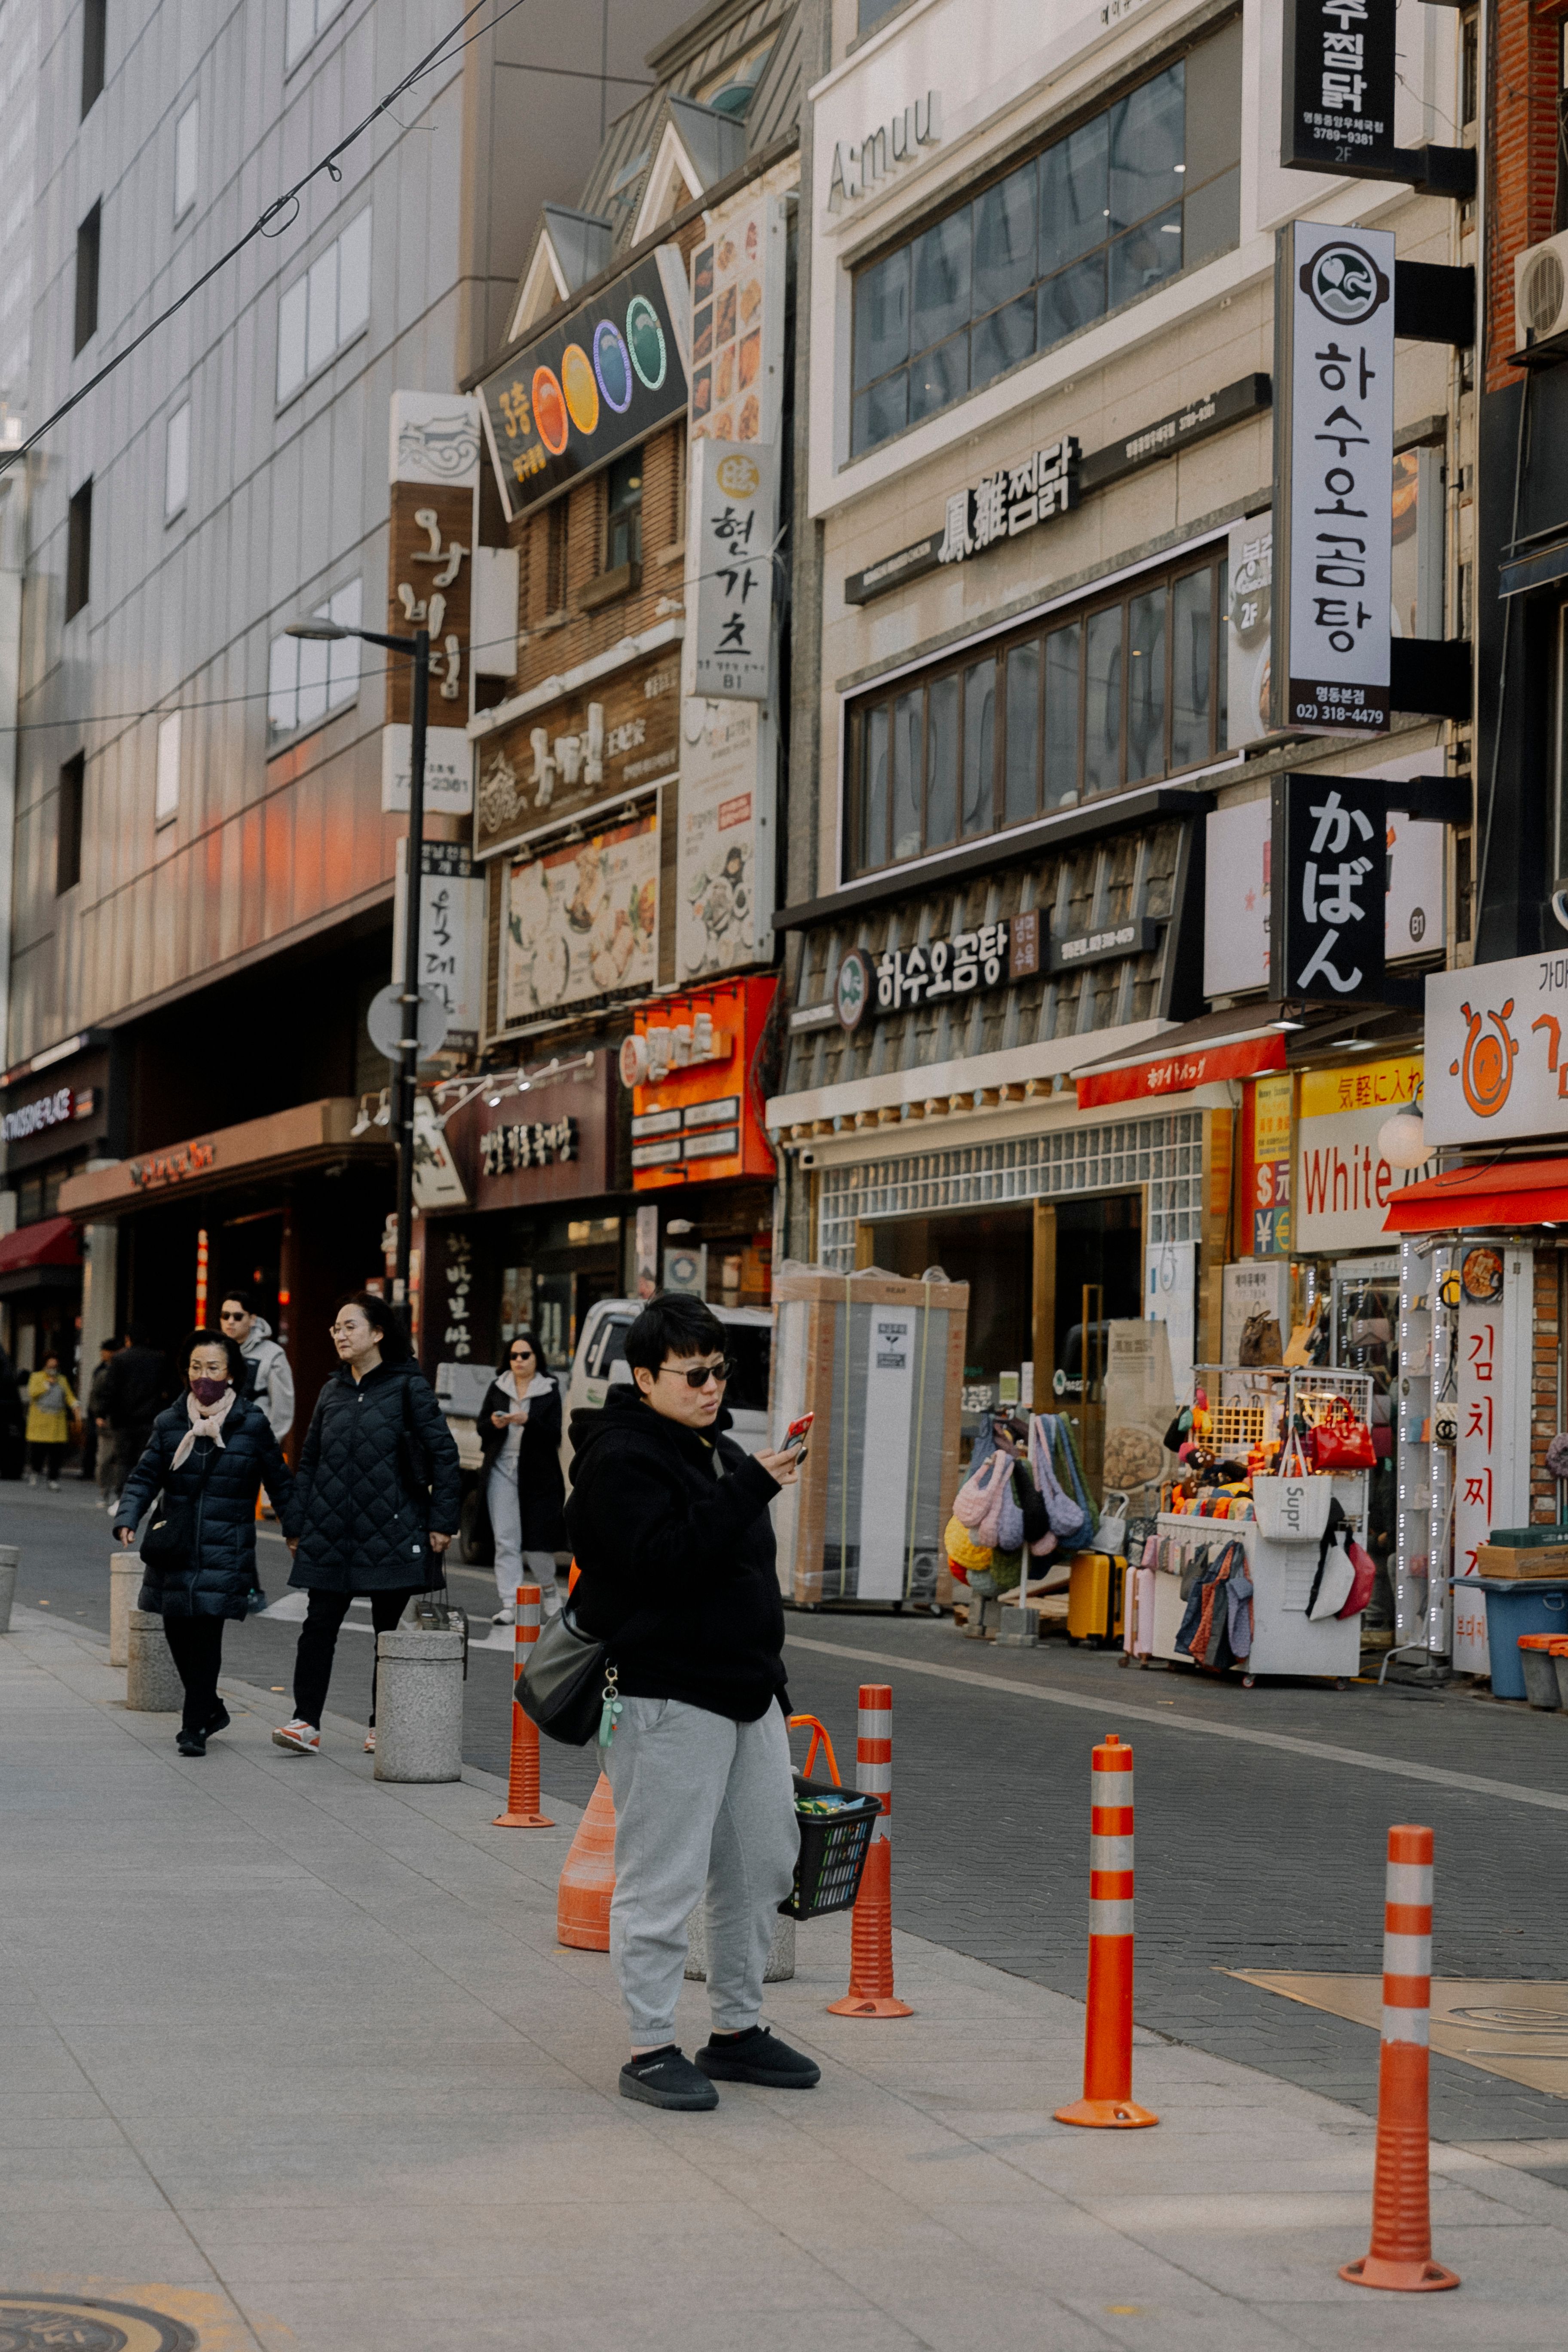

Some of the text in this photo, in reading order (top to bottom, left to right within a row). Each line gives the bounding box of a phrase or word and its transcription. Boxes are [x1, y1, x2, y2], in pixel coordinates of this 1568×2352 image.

[1314, 127, 1373, 145] 3789-9381
[1335, 146, 1352, 162] 2F
[1241, 602, 1258, 629] 2F
[1316, 686, 1365, 705] 명동본점
[1296, 704, 1384, 724] 02) 318-4479
[1297, 790, 1374, 992] かばん
[1412, 916, 1426, 935] B1
[877, 923, 1008, 1009] 하수오곰탕
[1305, 1144, 1392, 1215] White
[1464, 1325, 1494, 1578] 김치찌
